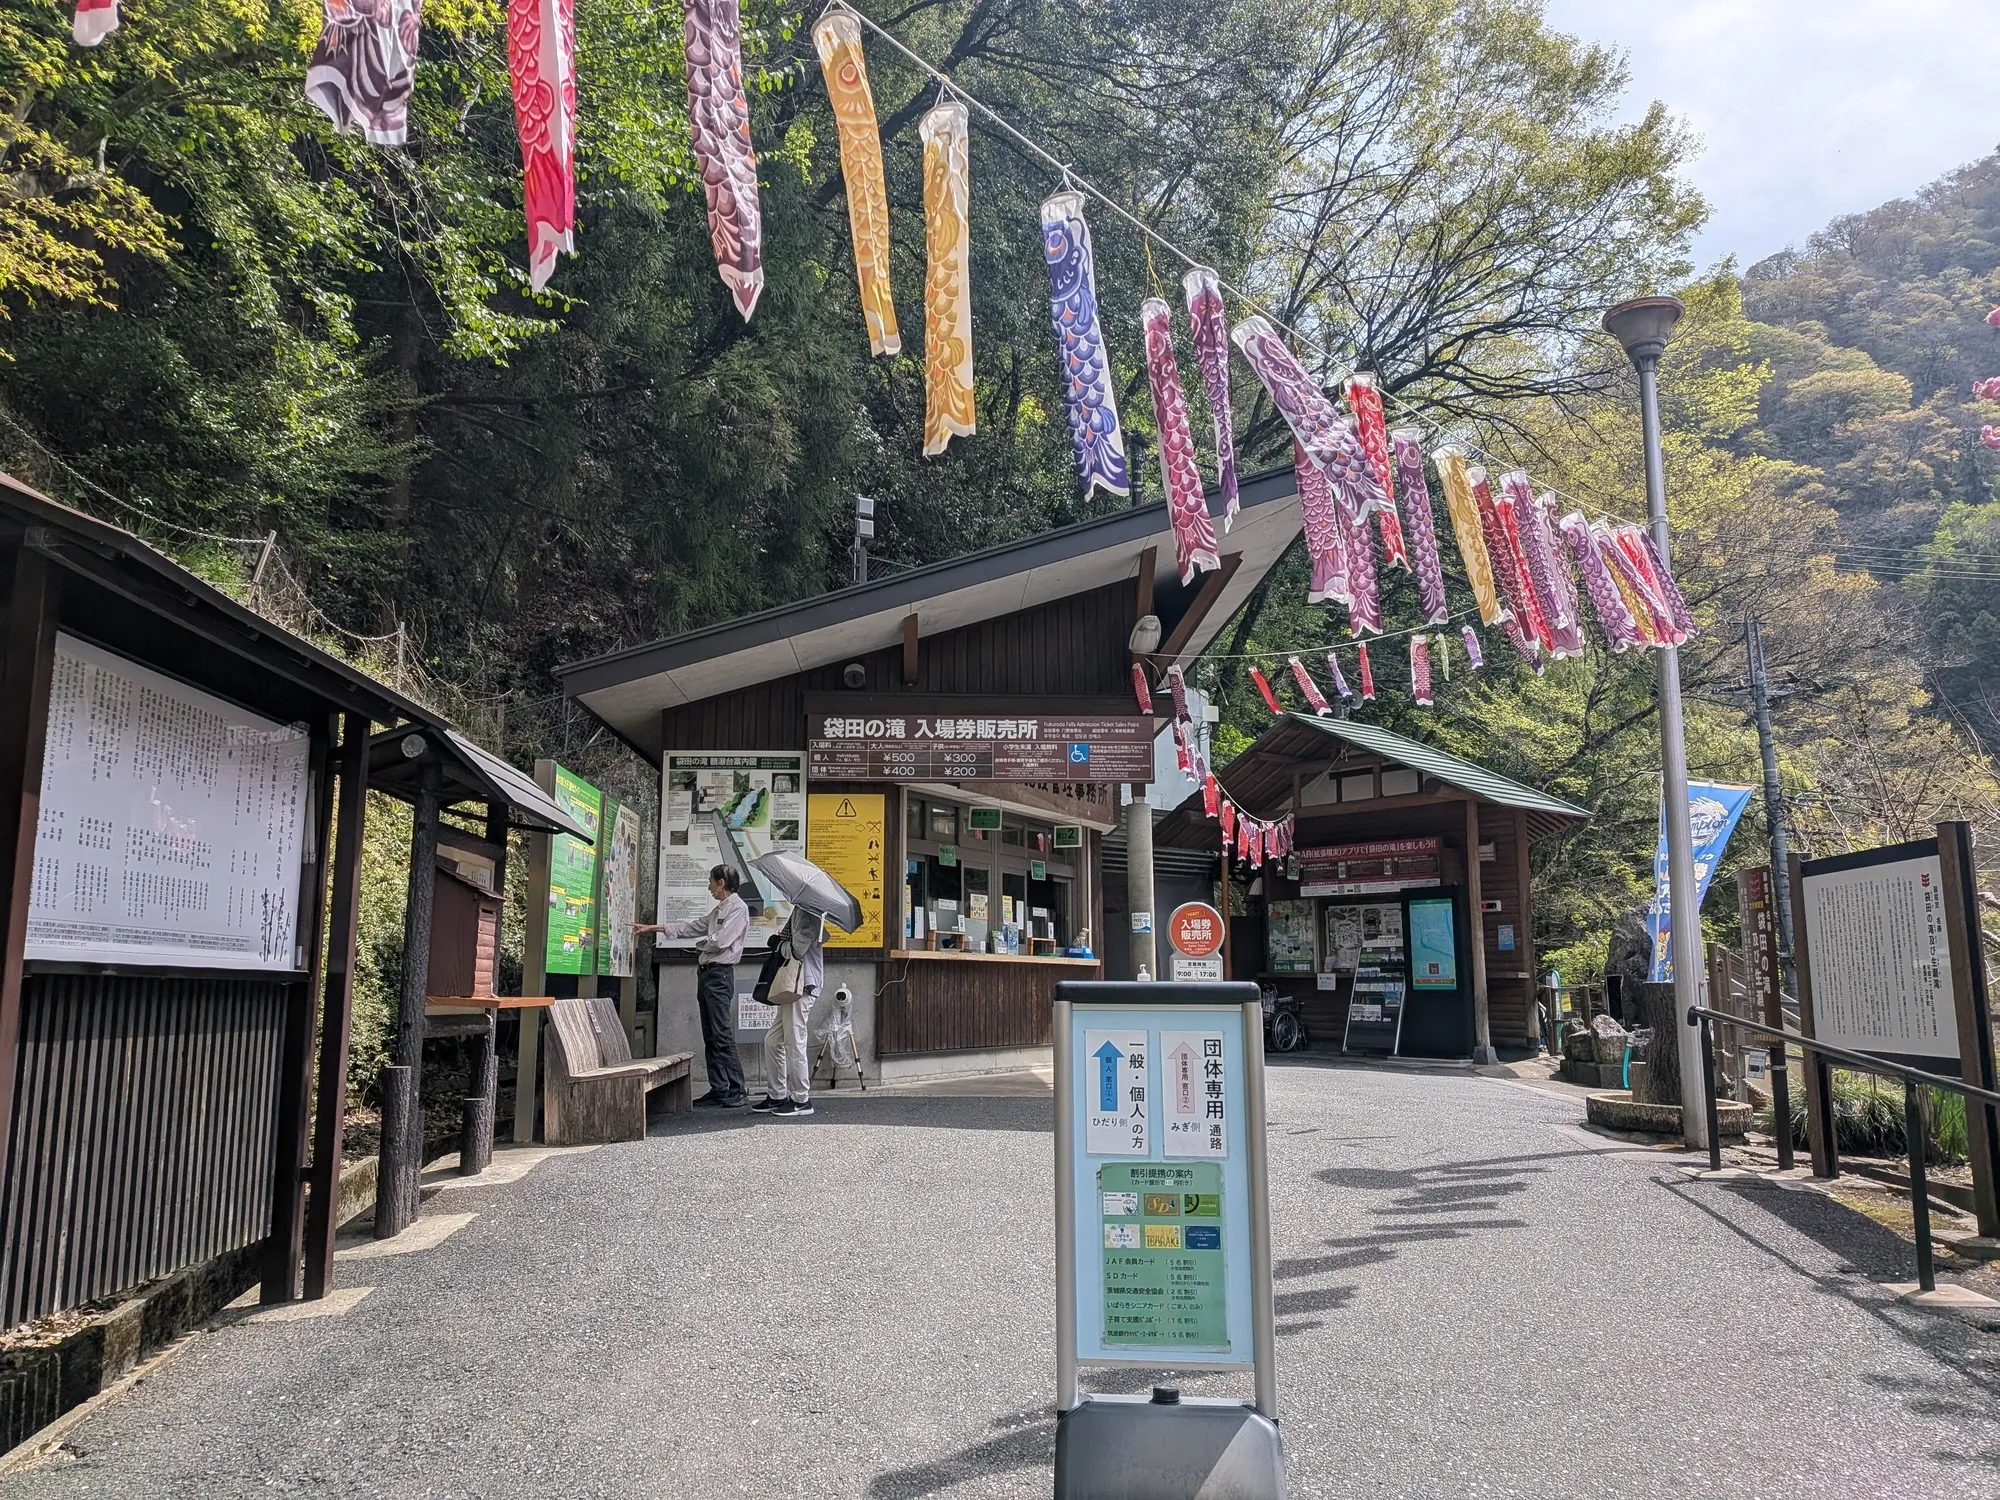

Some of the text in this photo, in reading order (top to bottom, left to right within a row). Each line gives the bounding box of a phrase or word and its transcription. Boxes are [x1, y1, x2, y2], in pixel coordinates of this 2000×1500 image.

[824, 718, 1038, 740] 袋田の滝 入場券販売所
[811, 741, 832, 749] 入場料
[870, 742, 884, 750] 大人
[931, 742, 944, 750] 子供
[1002, 743, 1058, 751] 小学生未満 入場無料
[676, 757, 708, 767] 袋田の滝
[813, 753, 830, 761] 個人
[882, 752, 915, 763] ¥500
[943, 752, 976, 763] ¥300
[811, 765, 827, 773] 団体
[882, 765, 915, 776] ¥400
[943, 766, 977, 777] ¥200
[1180, 919, 1211, 930] 入場券
[1936, 916, 1942, 933] 名勝
[1181, 930, 1212, 941] 販売所
[1924, 891, 1940, 990] 袋田の滝及び生瀬滝
[1757, 911, 1771, 994] 袋田の滝
[1105, 1056, 1113, 1073] 個人
[1180, 1053, 1189, 1081] 団体専用
[1128, 1041, 1145, 1149] 一般・個人の方
[1203, 1038, 1225, 1150] 団体専用 通路
[1092, 1117, 1128, 1127] ひだり側
[1170, 1122, 1201, 1133] みぎ側
[1130, 1168, 1193, 1179] 割引提携の案内
[1106, 1286, 1164, 1295] 茨城県交通安全協会
[1107, 1301, 1164, 1310] いばらきシニアカード
